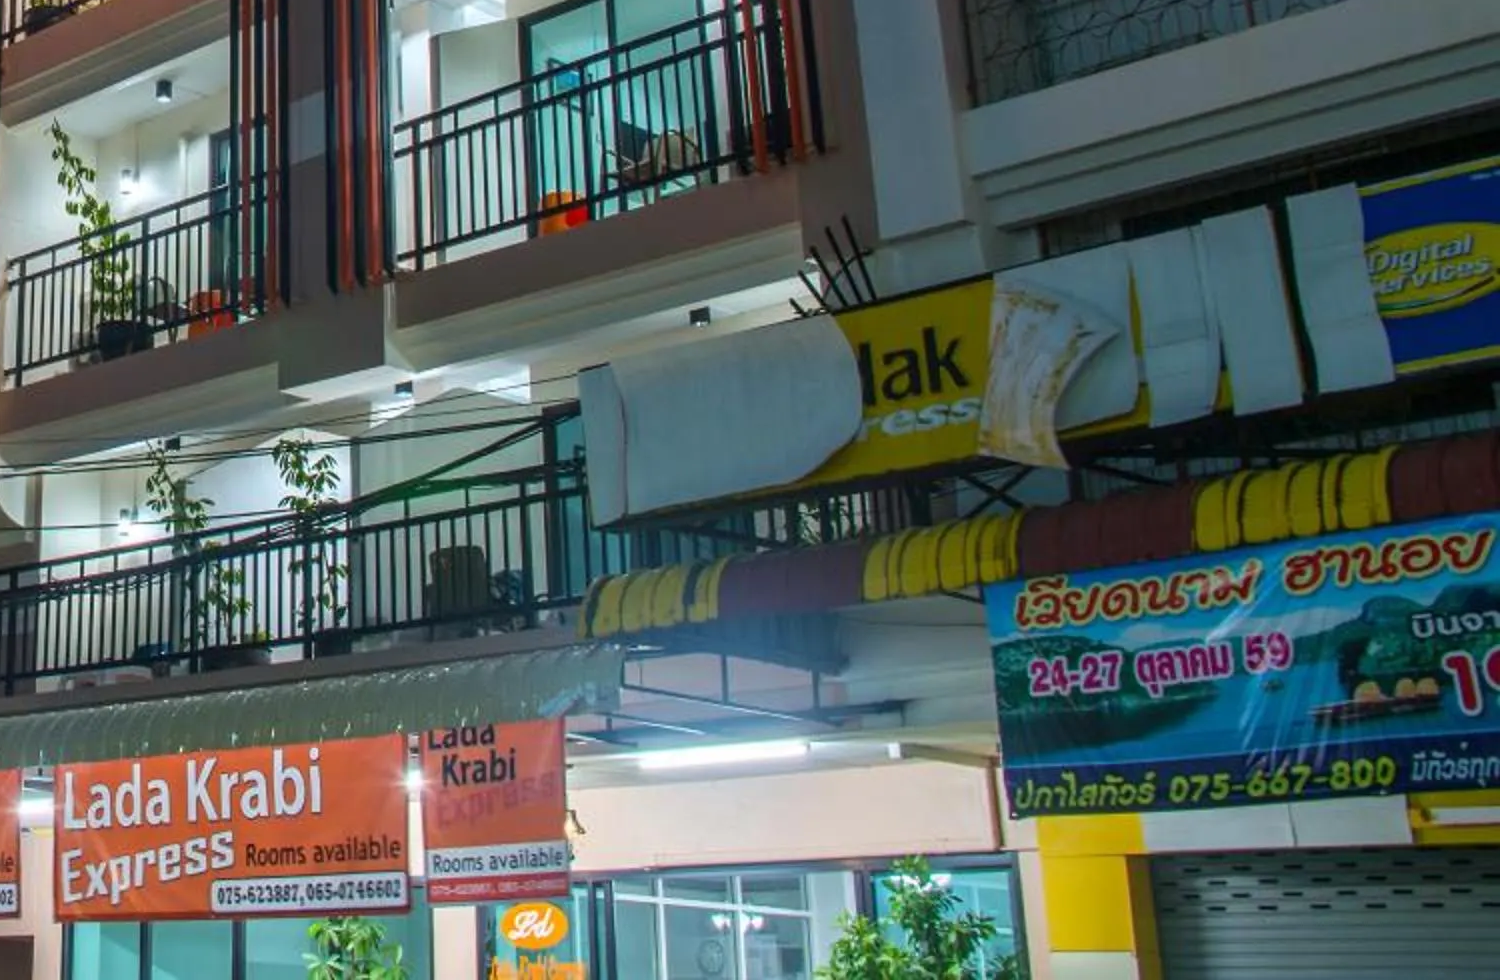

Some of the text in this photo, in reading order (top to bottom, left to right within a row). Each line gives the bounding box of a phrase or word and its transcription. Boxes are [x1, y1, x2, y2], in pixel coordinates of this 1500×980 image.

[1368, 232, 1474, 276] Digital
[1015, 531, 1493, 627] เวียดนาม ฮานอย
[1030, 632, 1292, 697] 24-27 ตุลาคม 59
[63, 747, 322, 830] Lada Krabi
[442, 748, 516, 787] Krabi
[1170, 755, 1396, 802] 075-667-800
[61, 831, 400, 906] Express Rooms available
[433, 847, 563, 872] Rooms available
